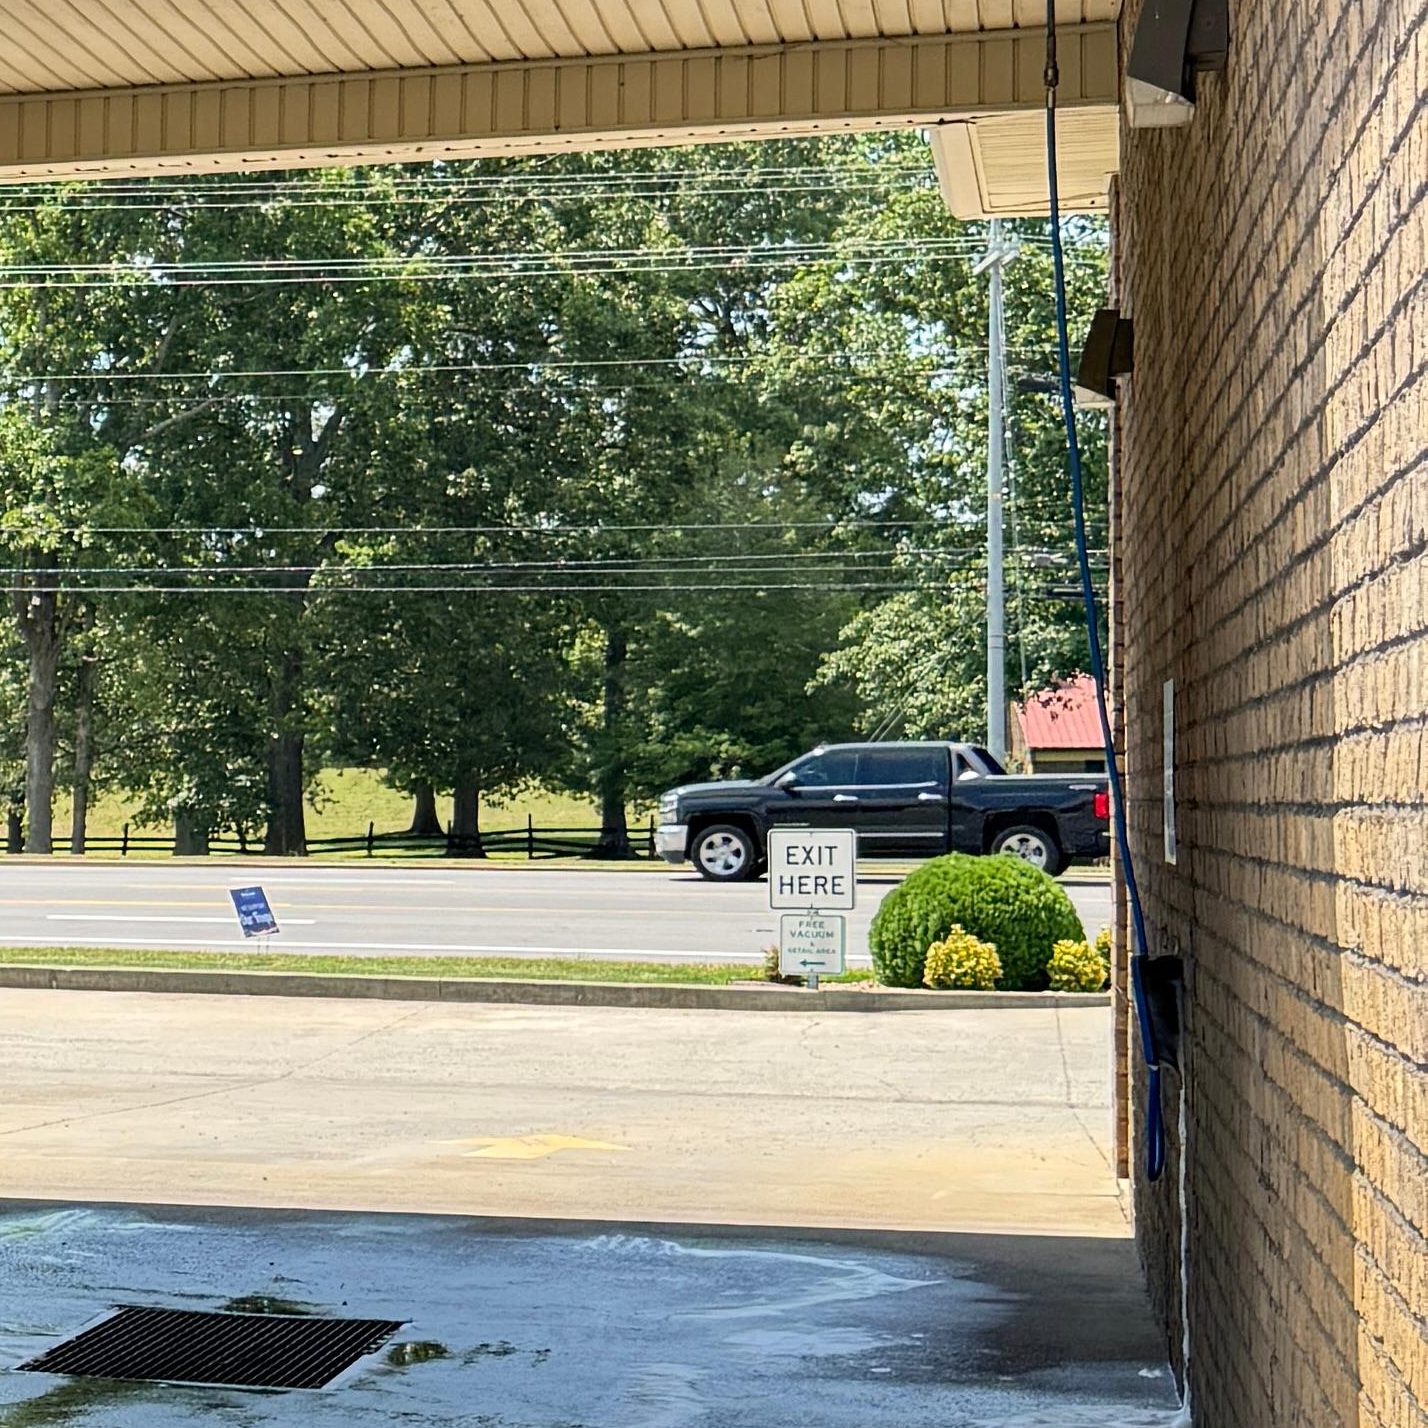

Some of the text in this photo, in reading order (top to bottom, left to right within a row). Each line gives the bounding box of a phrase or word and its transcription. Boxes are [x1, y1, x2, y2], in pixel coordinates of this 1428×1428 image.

[786, 845, 838, 866] EXIT
[779, 875, 845, 895] HERE
[799, 920, 825, 929] FREE
[790, 930, 834, 939] VACUUM
